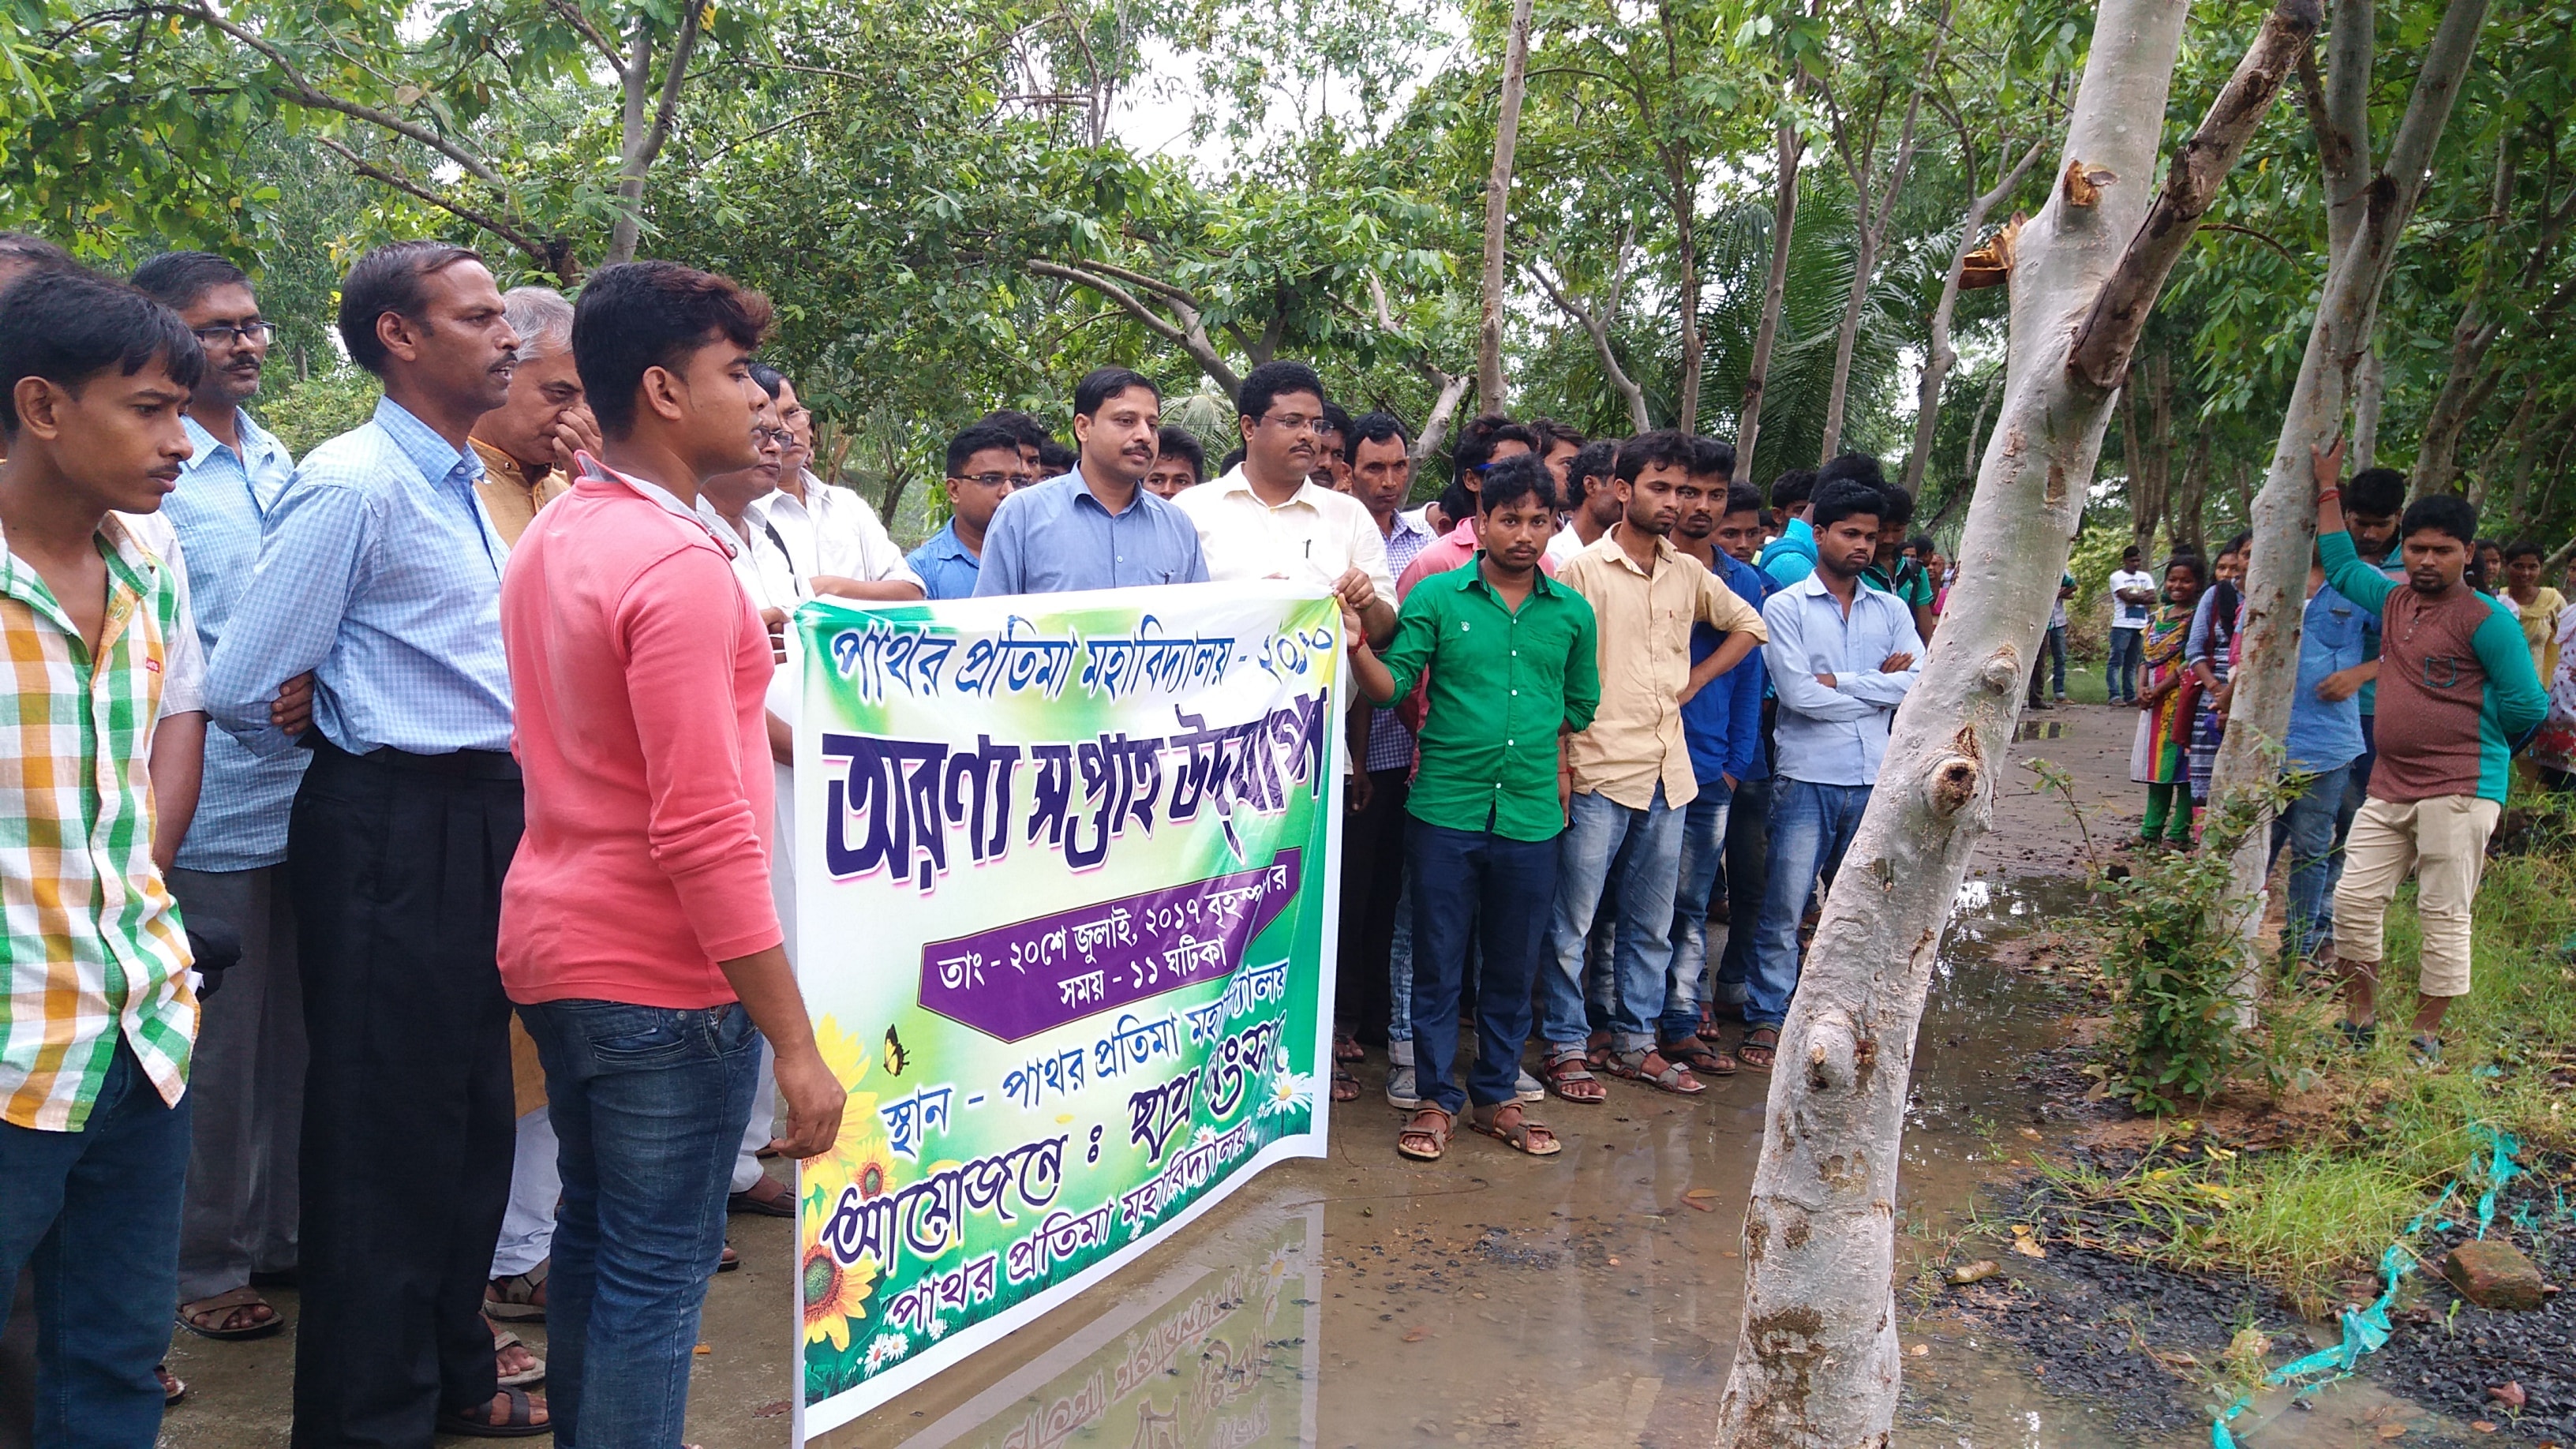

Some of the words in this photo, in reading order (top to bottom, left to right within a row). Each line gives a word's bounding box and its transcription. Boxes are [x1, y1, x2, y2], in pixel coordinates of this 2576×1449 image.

[833, 623, 957, 702] পাথর
[955, 614, 1080, 699] প্রতিমা
[1082, 614, 1236, 702] মহাবিদ্যালয়
[822, 732, 1021, 890] অরণ্য
[1028, 732, 1165, 869] সপ্তাহ
[937, 950, 986, 990] তাং
[1009, 924, 1067, 975] ২০শে
[1071, 904, 1139, 964] জুলাই,
[1145, 898, 1201, 938] ২০১৭
[1057, 969, 1105, 1009] সময়
[1130, 956, 1159, 989] ১১
[1162, 934, 1227, 978] ঘটিকা
[880, 1087, 953, 1159] স্থান
[1002, 1047, 1085, 1109] পাথর
[1095, 1011, 1179, 1078] প্রতিমা
[823, 1133, 1069, 1272] আয়োজনে
[1127, 1068, 1199, 1163] ছাত্র
[893, 1255, 996, 1329] পাথর
[1009, 1200, 1114, 1279] প্রতিমা
[1122, 1119, 1251, 1222] মহাবিদ্যালয়
